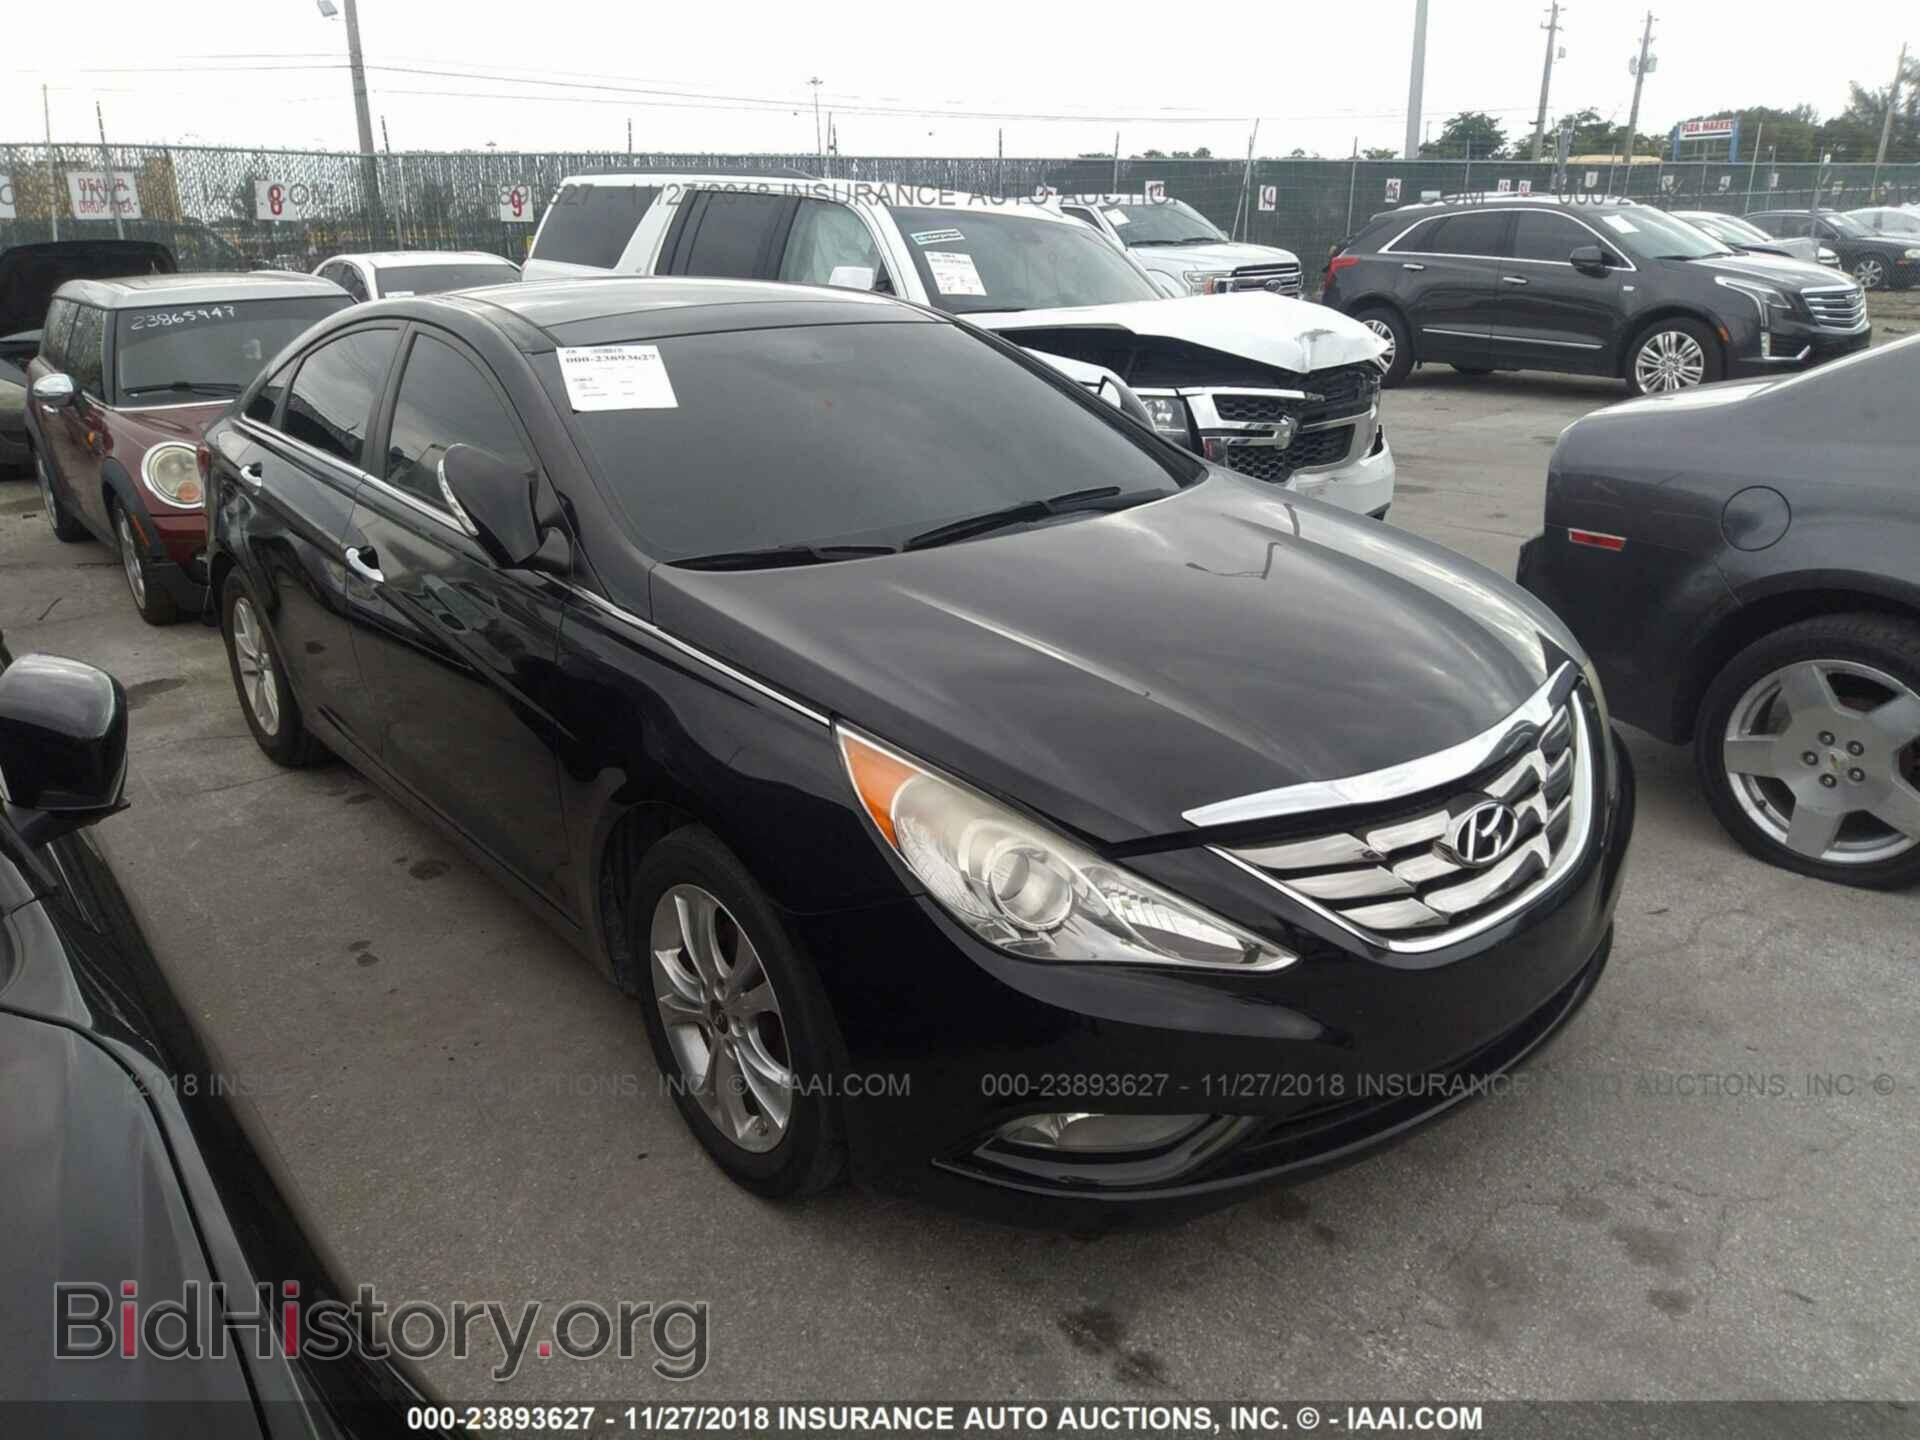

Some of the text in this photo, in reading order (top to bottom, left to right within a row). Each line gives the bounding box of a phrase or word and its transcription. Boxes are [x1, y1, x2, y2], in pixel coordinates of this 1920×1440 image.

[78, 178, 126, 191] DEALR
[109, 201, 135, 213] AEA
[269, 185, 283, 215] 8
[511, 190, 522, 216] 9
[131, 305, 235, 330] 23865947
